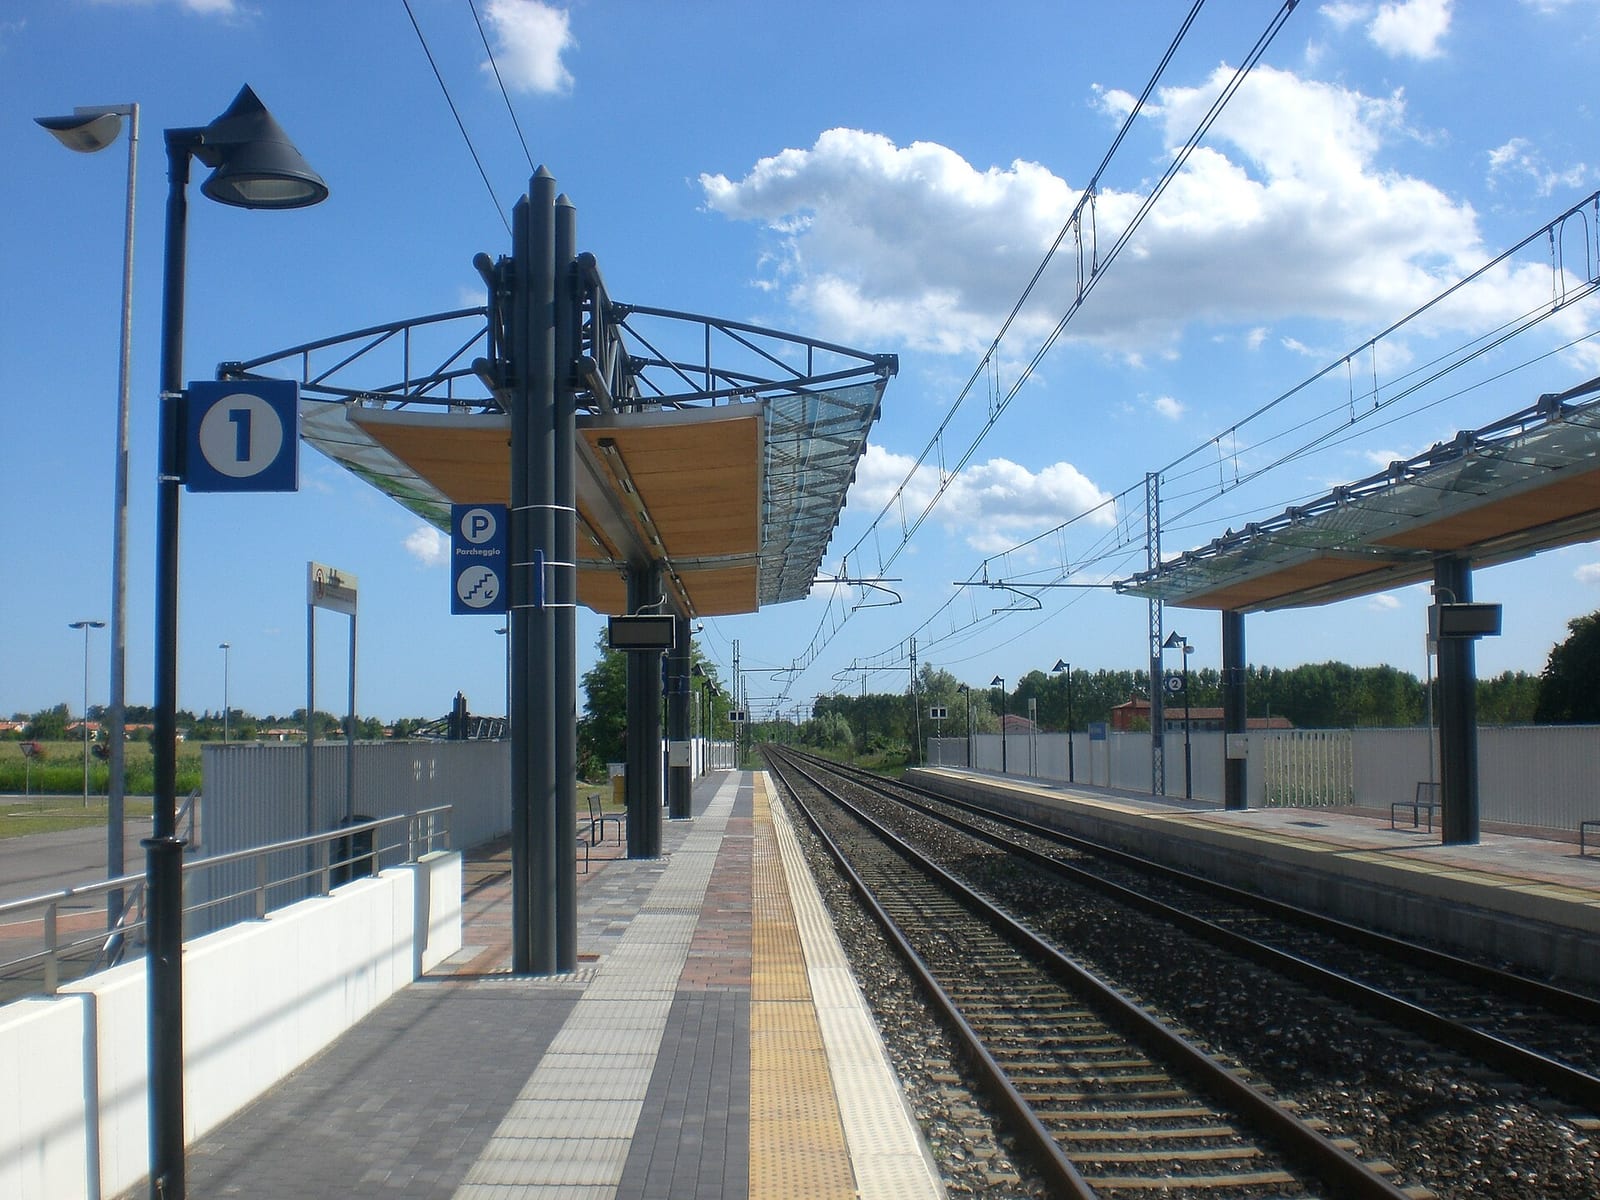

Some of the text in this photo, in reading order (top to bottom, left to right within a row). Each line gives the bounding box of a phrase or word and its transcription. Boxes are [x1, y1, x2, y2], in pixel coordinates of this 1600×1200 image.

[228, 408, 251, 462] 1
[471, 515, 489, 538] P
[456, 548, 501, 557] Parcheggio
